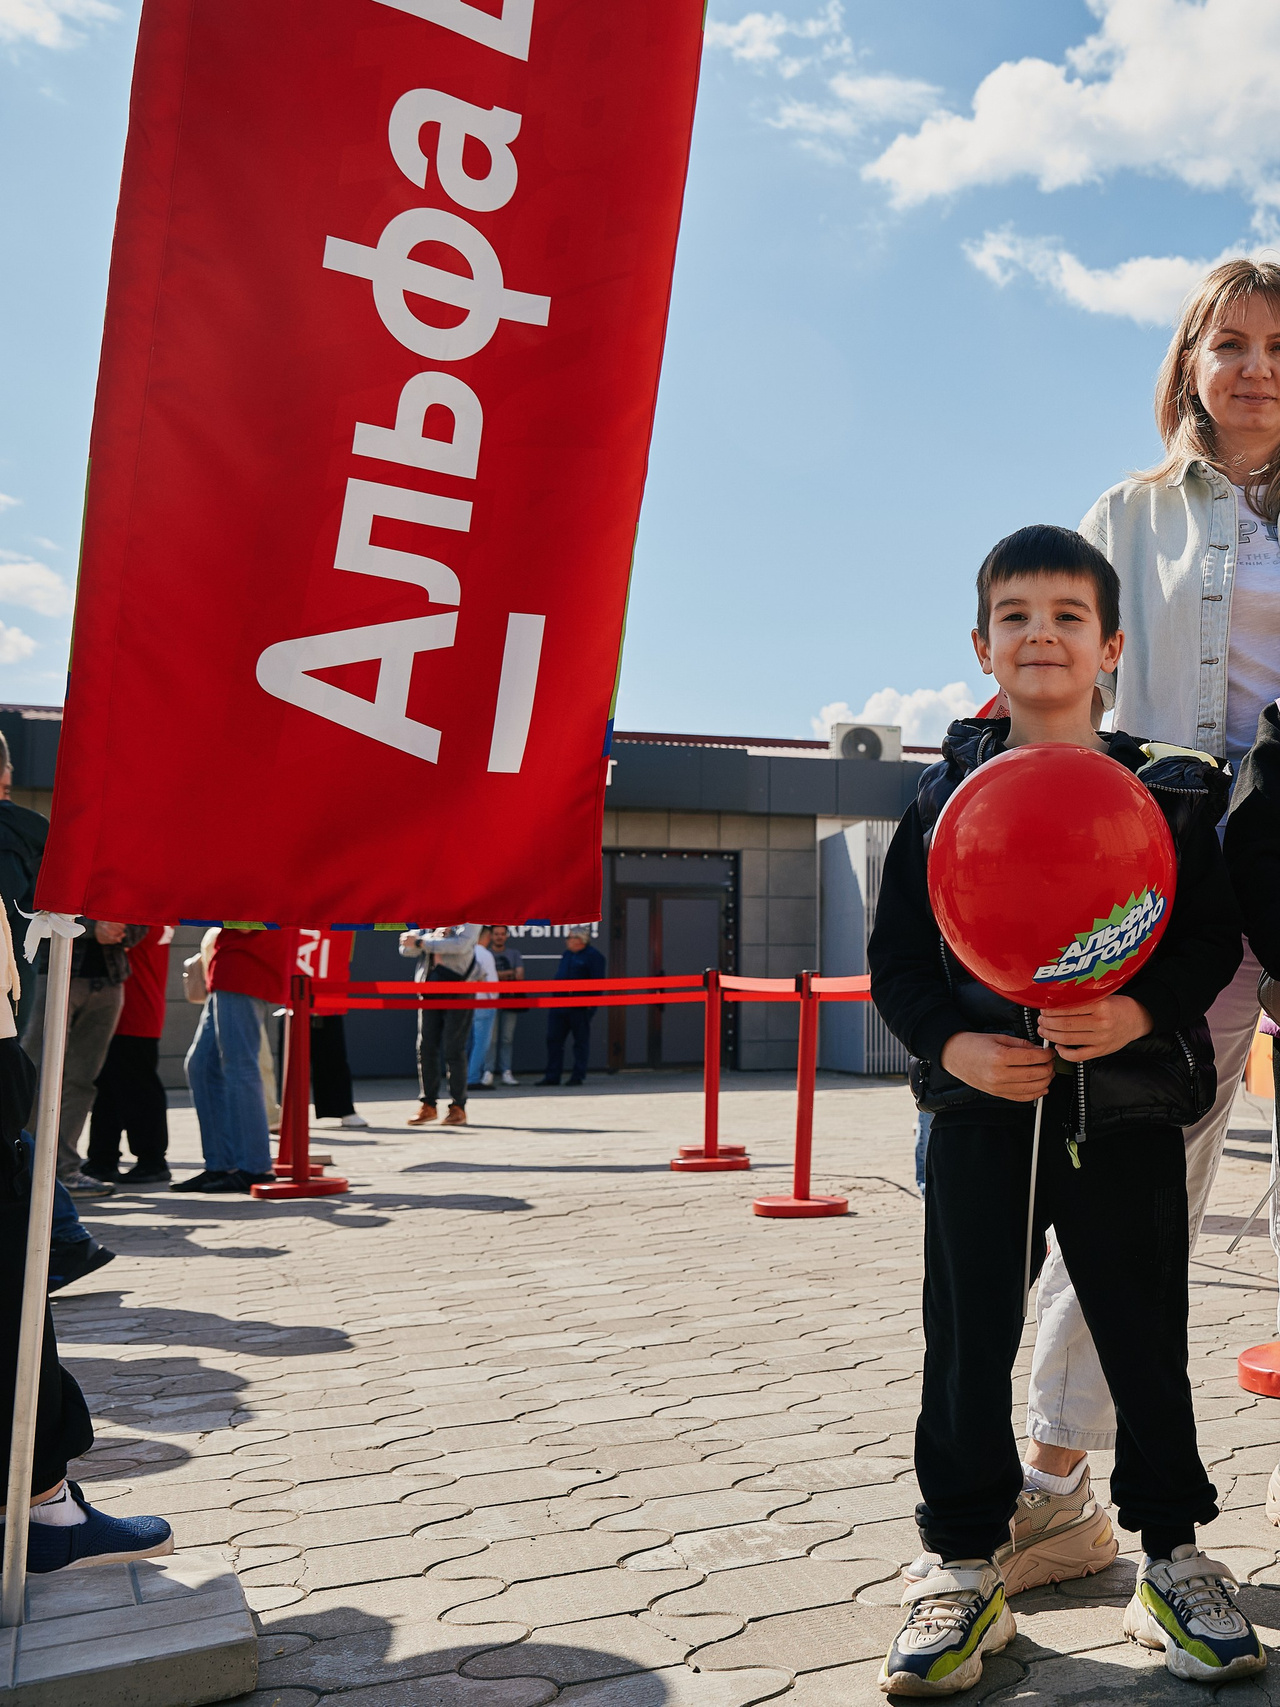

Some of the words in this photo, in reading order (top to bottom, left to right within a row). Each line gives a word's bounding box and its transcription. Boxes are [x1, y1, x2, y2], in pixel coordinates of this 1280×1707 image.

[256, 88, 551, 769] Альфа
[1033, 897, 1166, 981] ВЫГОДНО
[1058, 891, 1155, 963] АЛЬФА
